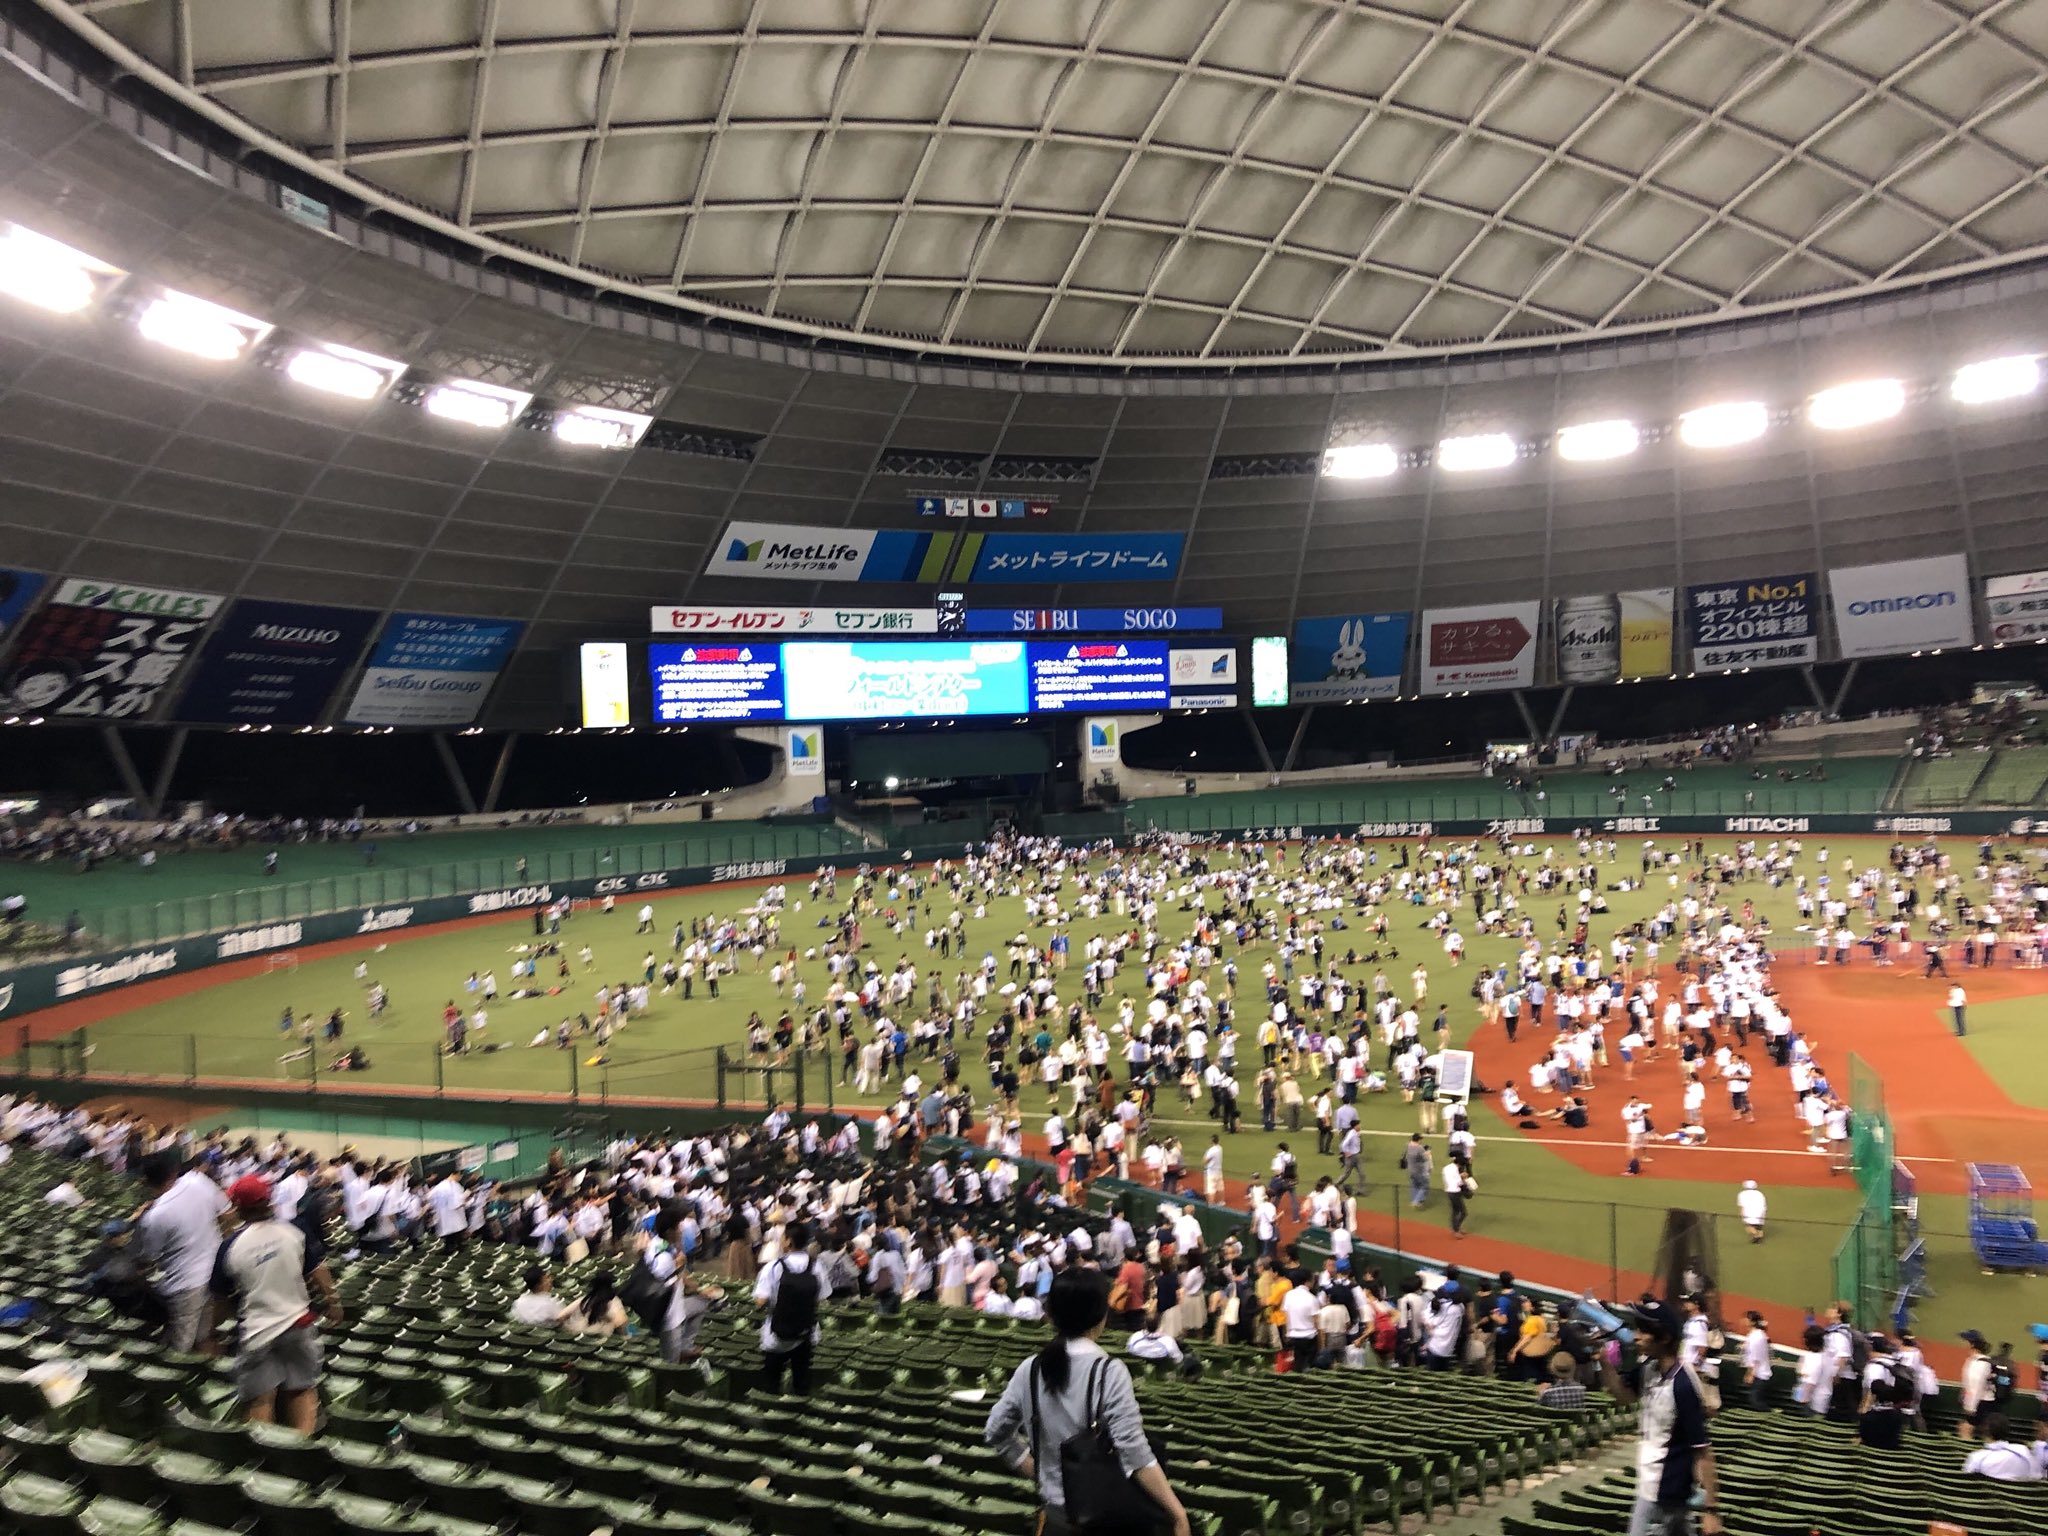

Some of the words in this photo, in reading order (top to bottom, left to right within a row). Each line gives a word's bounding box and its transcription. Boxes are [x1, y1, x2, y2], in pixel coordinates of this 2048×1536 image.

[767, 543, 858, 562] MetLife
[988, 550, 1169, 571] メットライフドーム
[763, 562, 838, 571] メットライフ生命
[1693, 587, 1739, 608] 東京
[1747, 579, 1807, 603] No.1
[671, 610, 786, 629] セブン-イレブン
[835, 611, 914, 630] セブン銀行
[1013, 609, 1079, 631] SEIBU
[1124, 609, 1178, 630] SOGO
[1699, 600, 1806, 623] オフィスビル
[250, 623, 341, 645] MIZUHO
[1560, 625, 1618, 648] Asahi
[1698, 614, 1809, 643] 220棟超
[1703, 643, 1808, 667] 住友不動産
[374, 674, 427, 691] Seibu
[429, 678, 482, 694] Group
[1180, 696, 1228, 708] Panasonic
[1255, 826, 1304, 842] 大林組
[1726, 817, 1810, 832] HITACHI
[711, 859, 787, 882] 三井住友銀行
